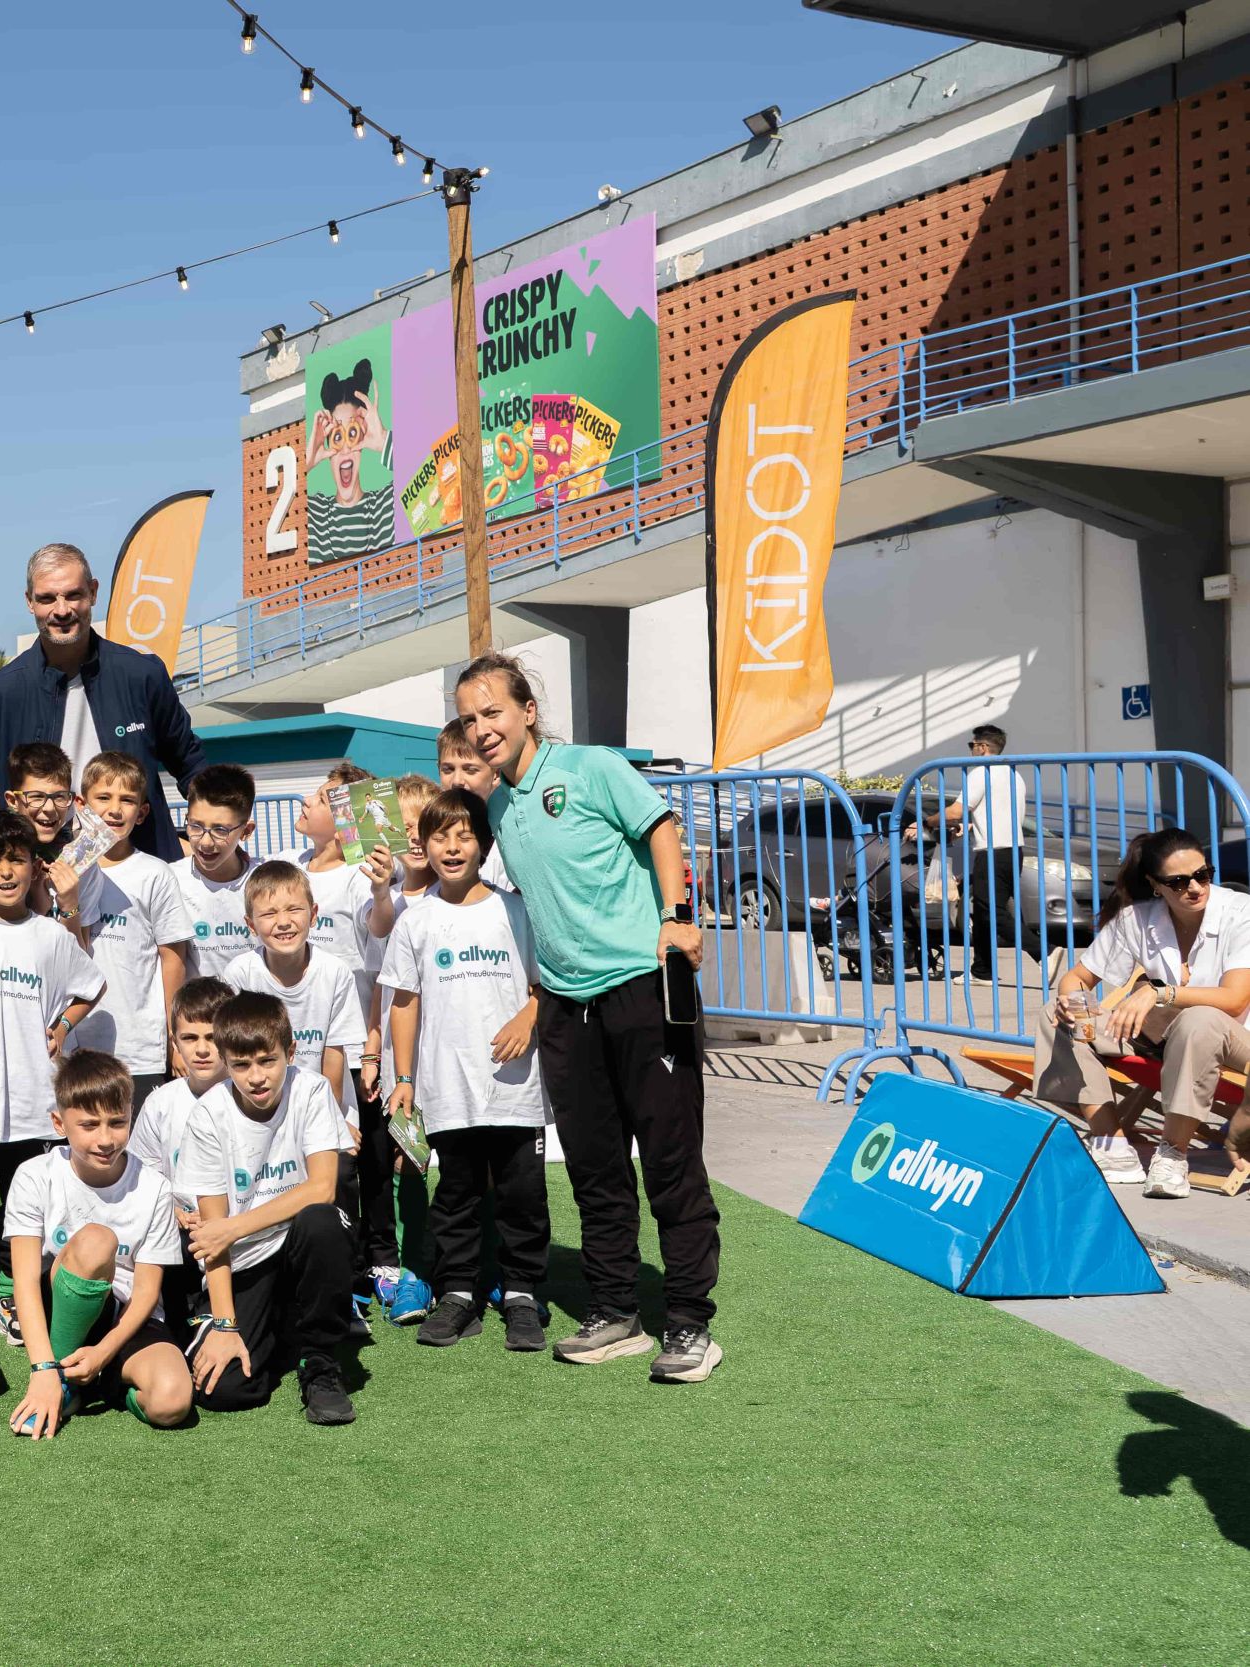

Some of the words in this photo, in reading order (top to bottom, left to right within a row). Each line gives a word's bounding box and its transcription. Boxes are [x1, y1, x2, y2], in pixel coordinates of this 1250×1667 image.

[483, 269, 563, 335] CRISPY
[481, 395, 531, 432] !CKERS
[433, 431, 462, 465] P!CKE
[265, 446, 298, 554] 2
[740, 404, 812, 672] KIDOT
[100, 912, 127, 928] wyn
[458, 945, 510, 966] allwyn
[0, 966, 43, 990] allwyn
[293, 1029, 323, 1044] wyn
[888, 1138, 984, 1212] allwyn
